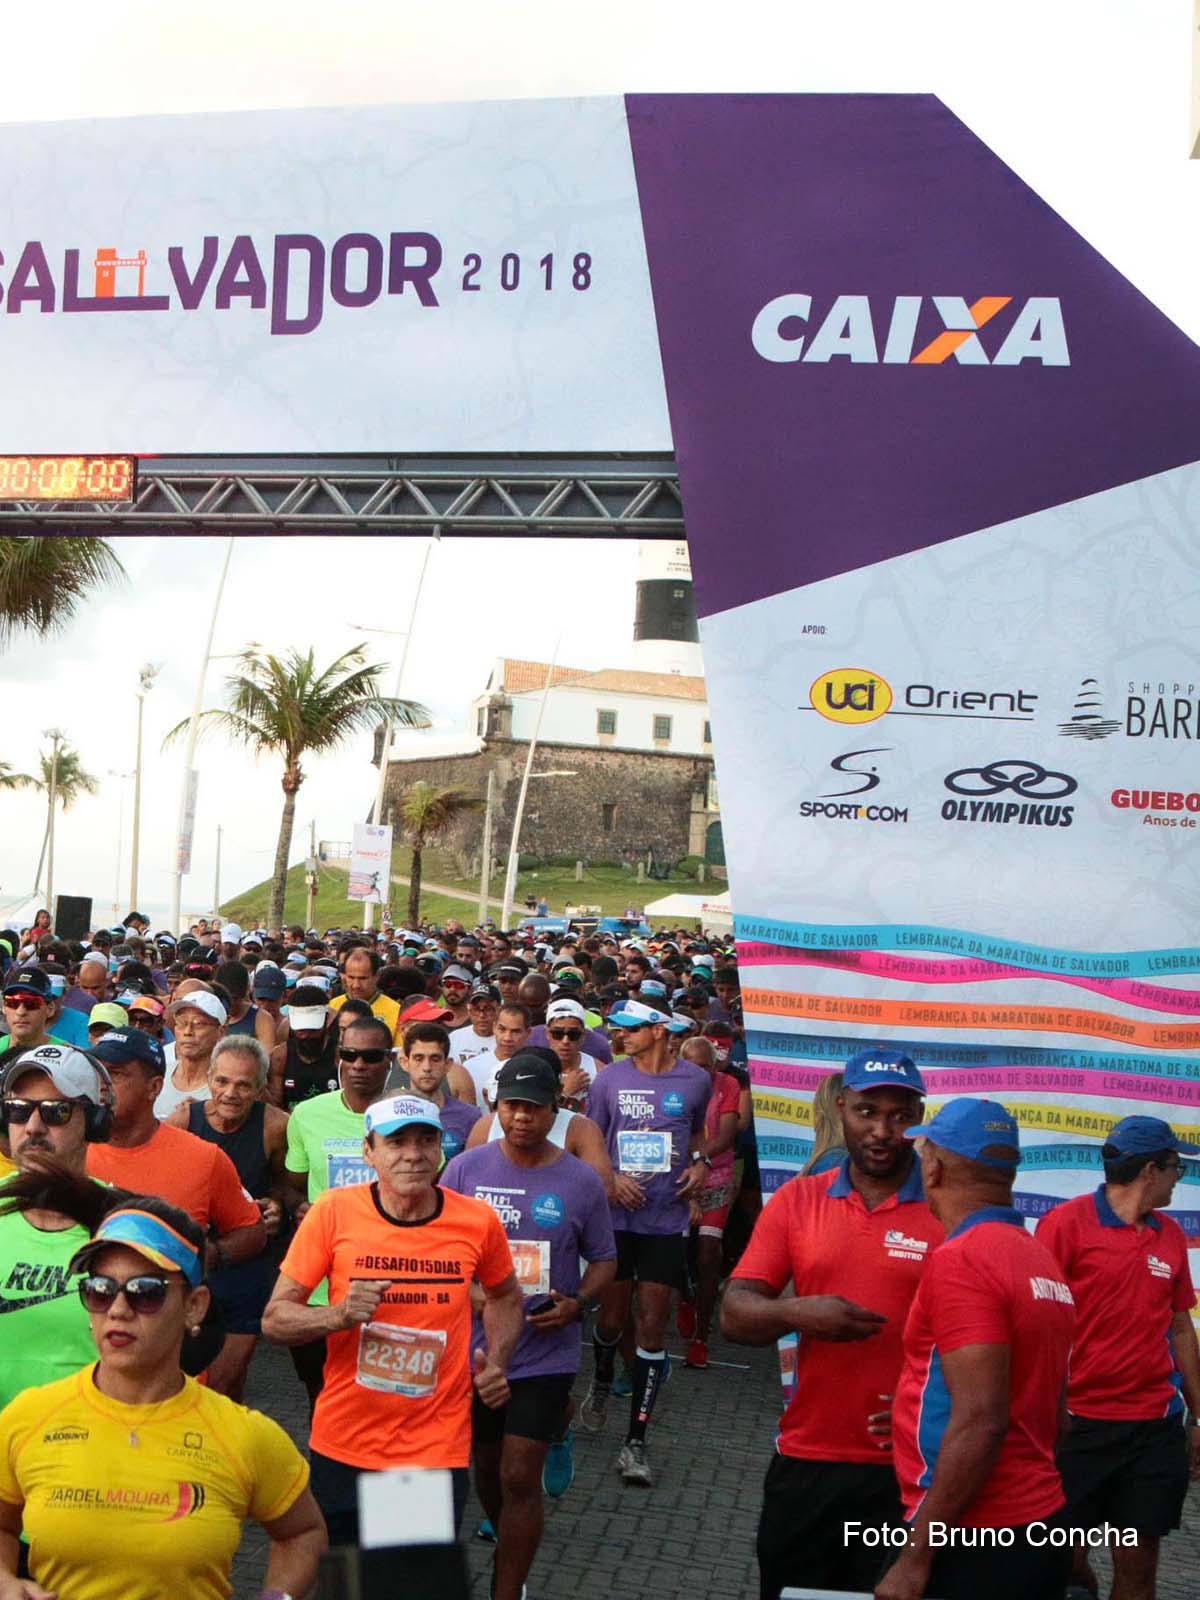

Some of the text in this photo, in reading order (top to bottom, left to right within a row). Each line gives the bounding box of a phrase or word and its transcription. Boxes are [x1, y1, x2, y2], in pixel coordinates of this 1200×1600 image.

[462, 252, 592, 292] 2018
[751, 293, 1071, 367] CAIXA
[905, 684, 1039, 714] Orient
[941, 799, 1074, 828] OLYMPIKUS
[1143, 813, 1197, 828] Anos de
[740, 926, 880, 947] MARATONA DE SALVADOR
[895, 931, 1131, 974] LEMBRANÇA DA MARATONA DE SALVADOR
[744, 992, 883, 1018] MARATONA DE SALVADOR
[899, 1007, 1136, 1038] LEMBRANÇA DA MARATONA DE SALVADOR
[1101, 1060, 1163, 1075] MARATONA
[1167, 1063, 1182, 1077] DE
[1103, 1076, 1194, 1099] LEMBRANÇA DA
[796, 1106, 811, 1119] DA
[1047, 1111, 1062, 1125] DA
[354, 1255, 462, 1275] #DESAFIO15DIAS
[5, 1262, 73, 1294] RUN
[379, 1292, 428, 1305] ALVADOR
[365, 1340, 436, 1377] 22348
[106, 1487, 170, 1506] MOURA
